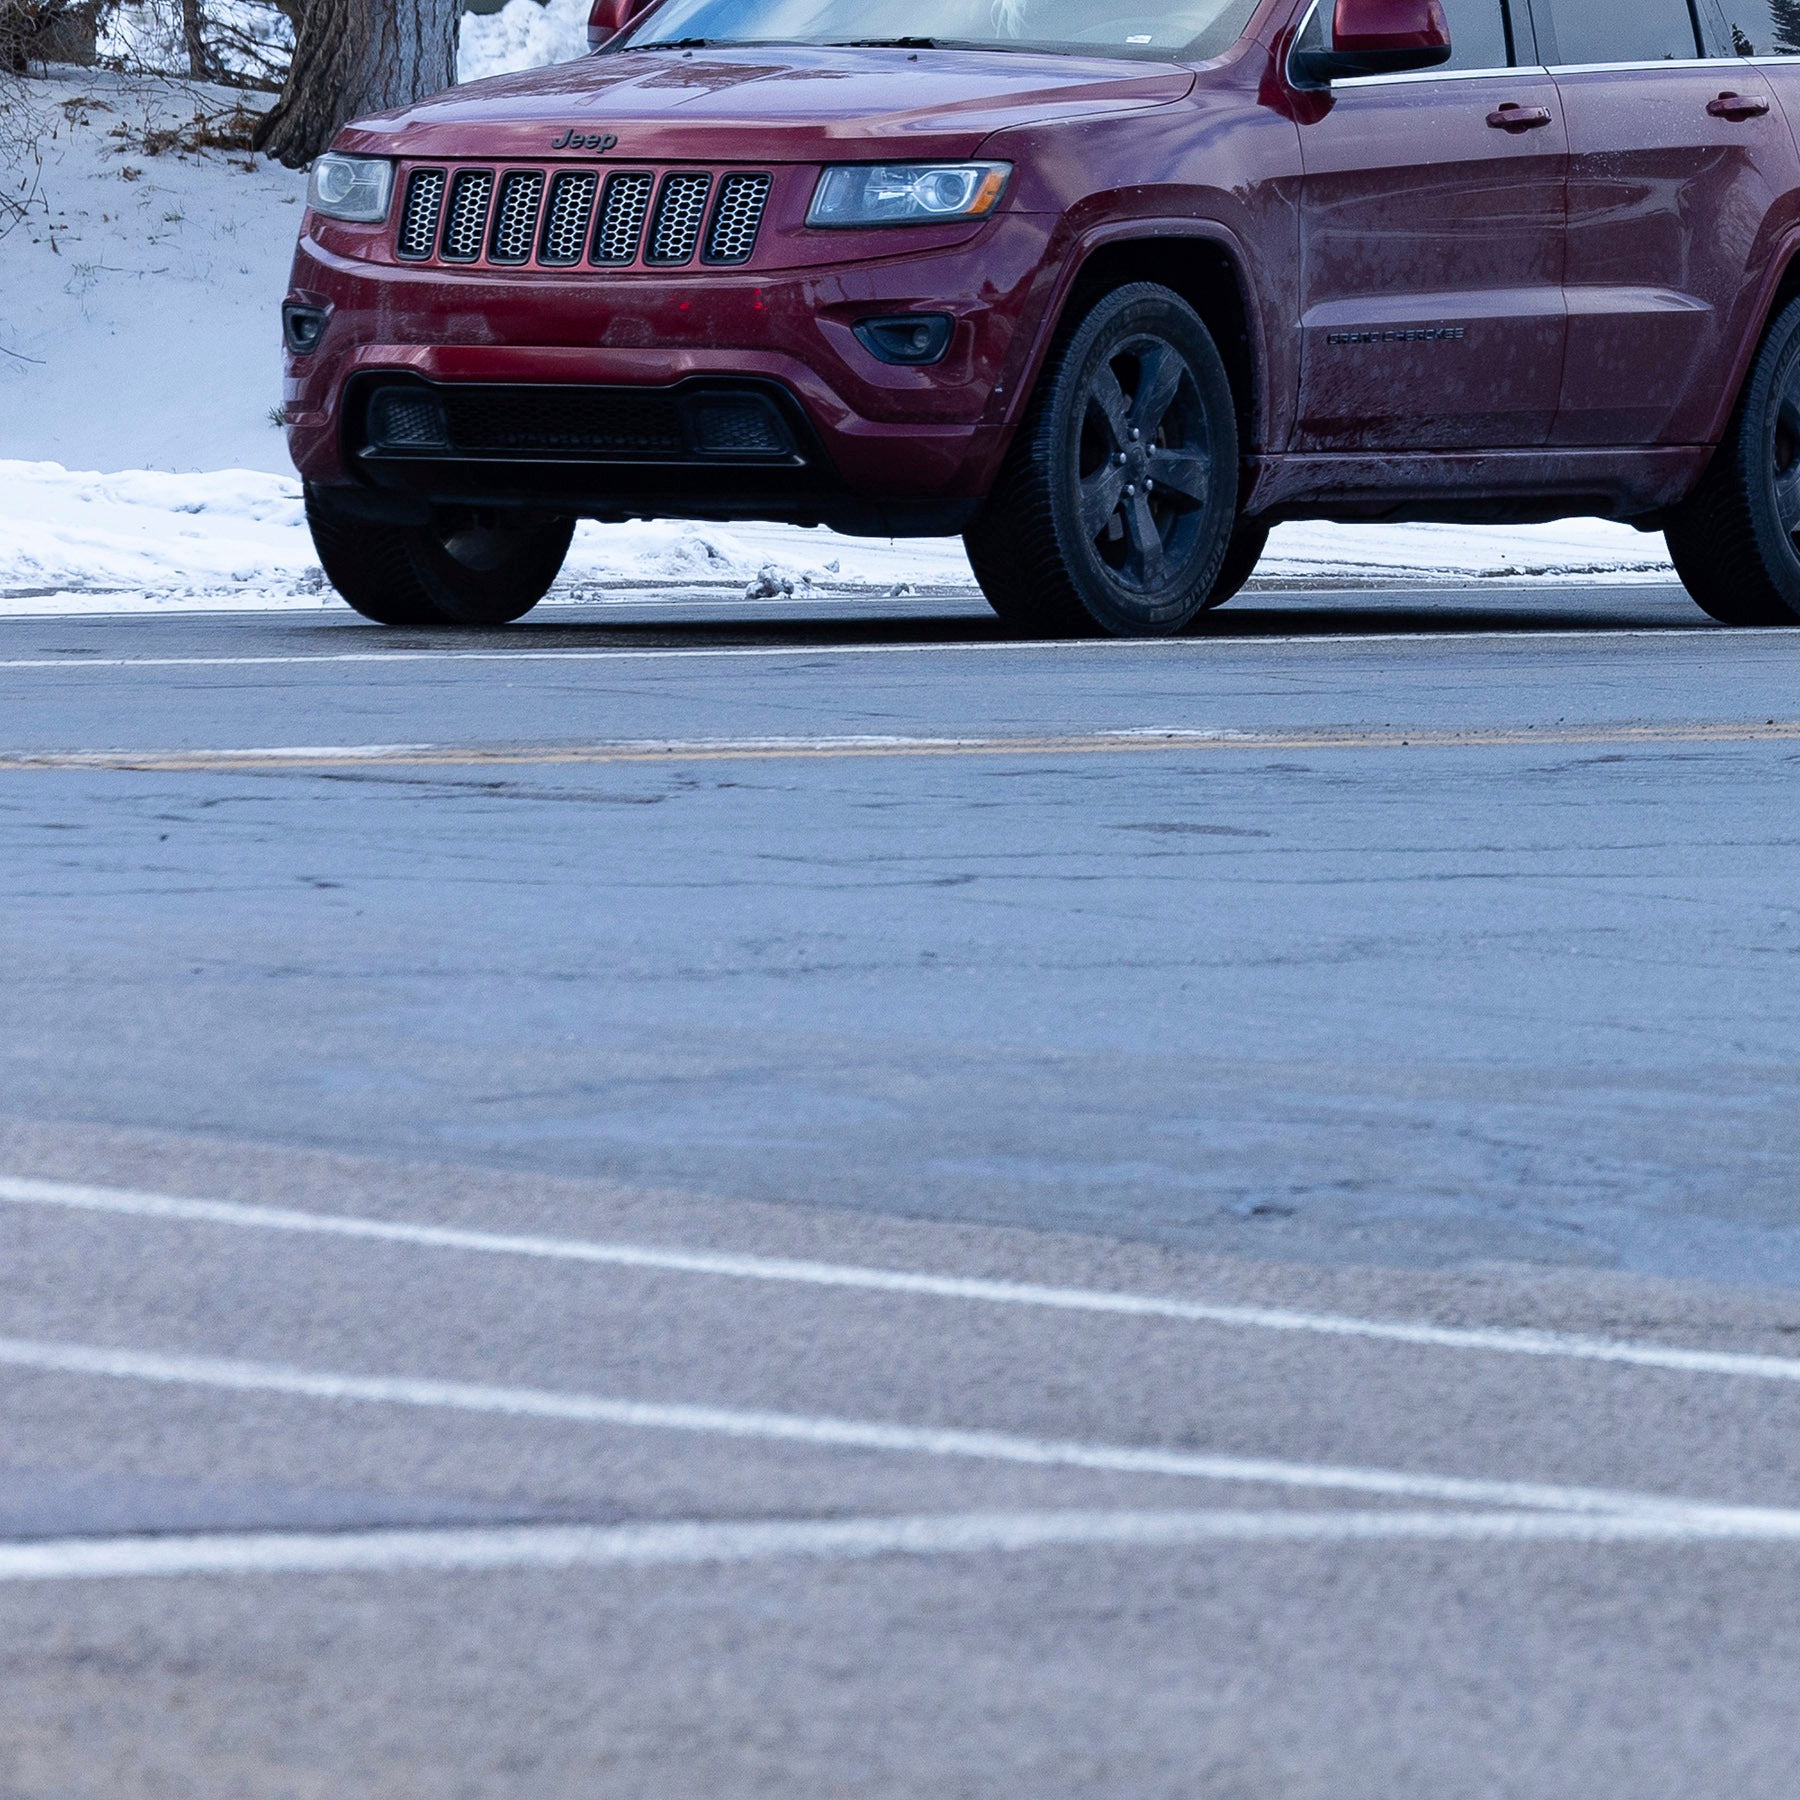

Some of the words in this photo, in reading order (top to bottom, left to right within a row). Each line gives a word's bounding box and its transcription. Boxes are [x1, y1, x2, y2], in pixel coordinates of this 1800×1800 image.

[551, 127, 618, 154] Jeep
[1327, 331, 1380, 345] GRAND
[1381, 328, 1465, 343] CHEROKEE
